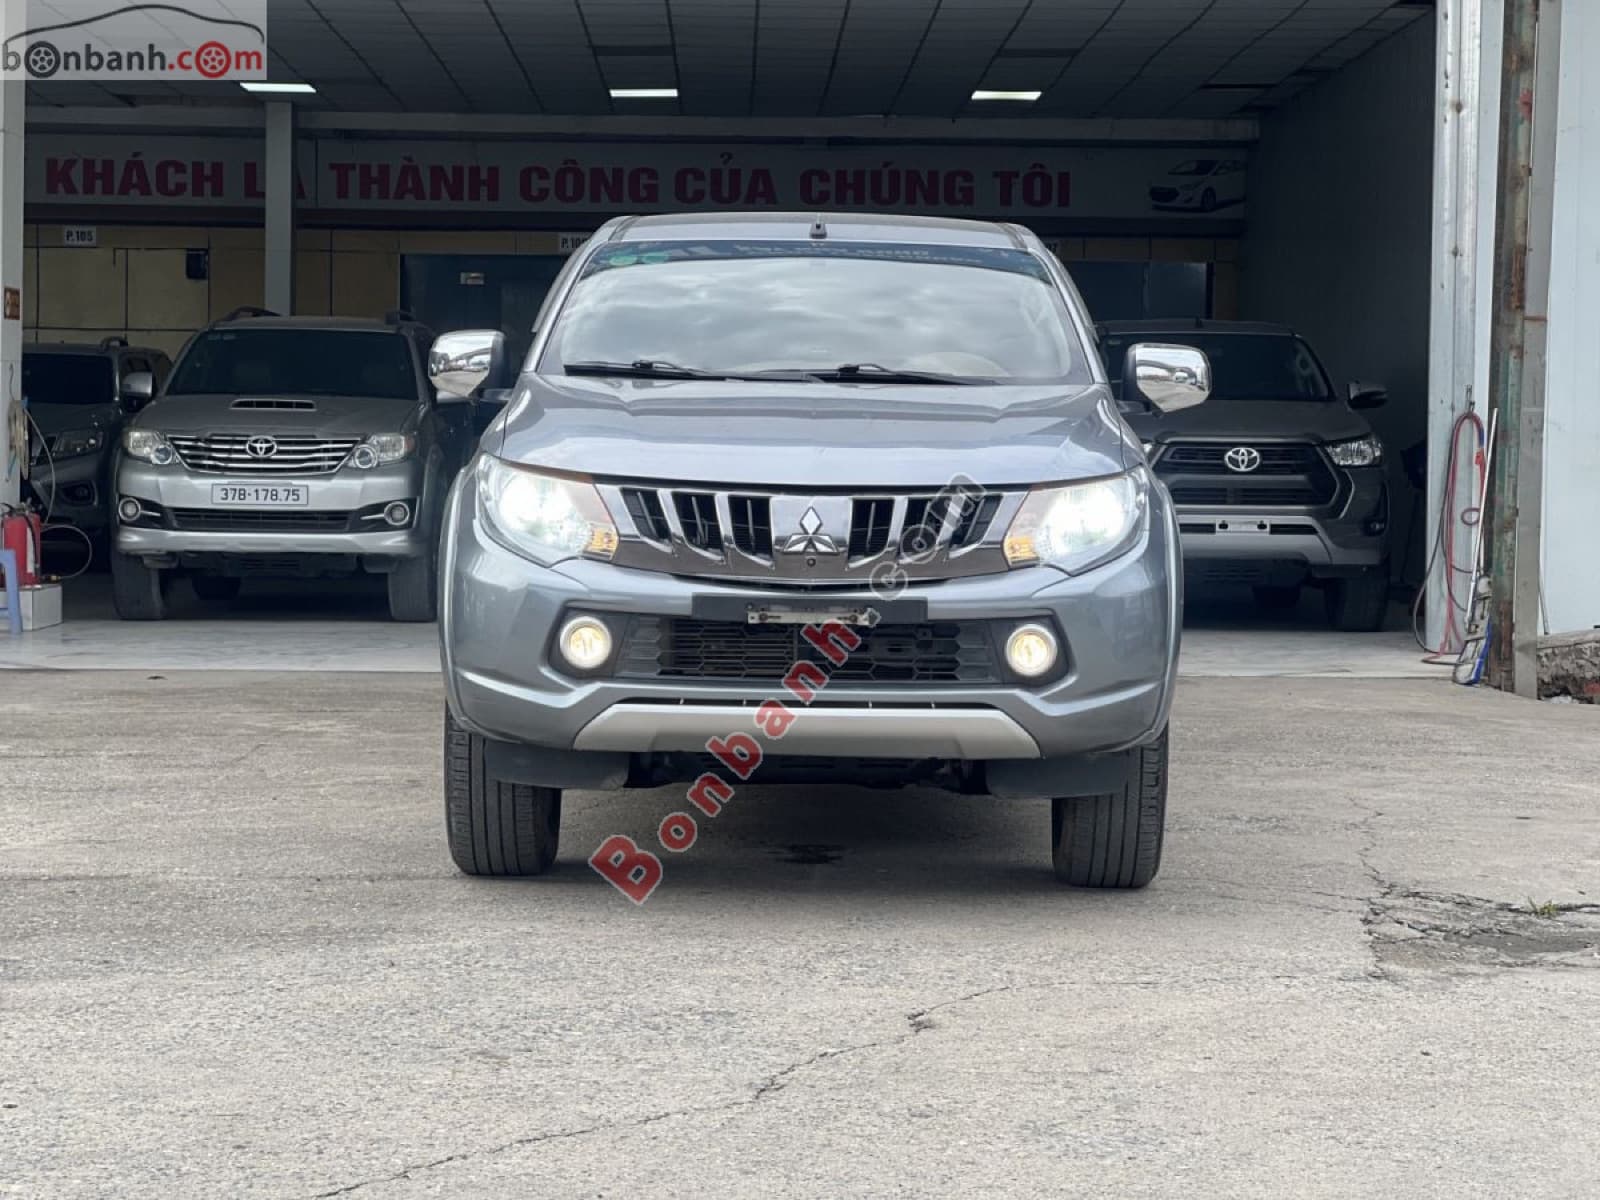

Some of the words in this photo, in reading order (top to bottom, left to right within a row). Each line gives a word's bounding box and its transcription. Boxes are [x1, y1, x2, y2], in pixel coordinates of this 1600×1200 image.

[45, 151, 223, 198] KHÁCH
[329, 156, 498, 201] THÀNH
[519, 158, 659, 204] CÔNG
[673, 151, 776, 206] CỦA
[800, 160, 975, 207] CHÚNG
[993, 163, 1072, 208] TÔI
